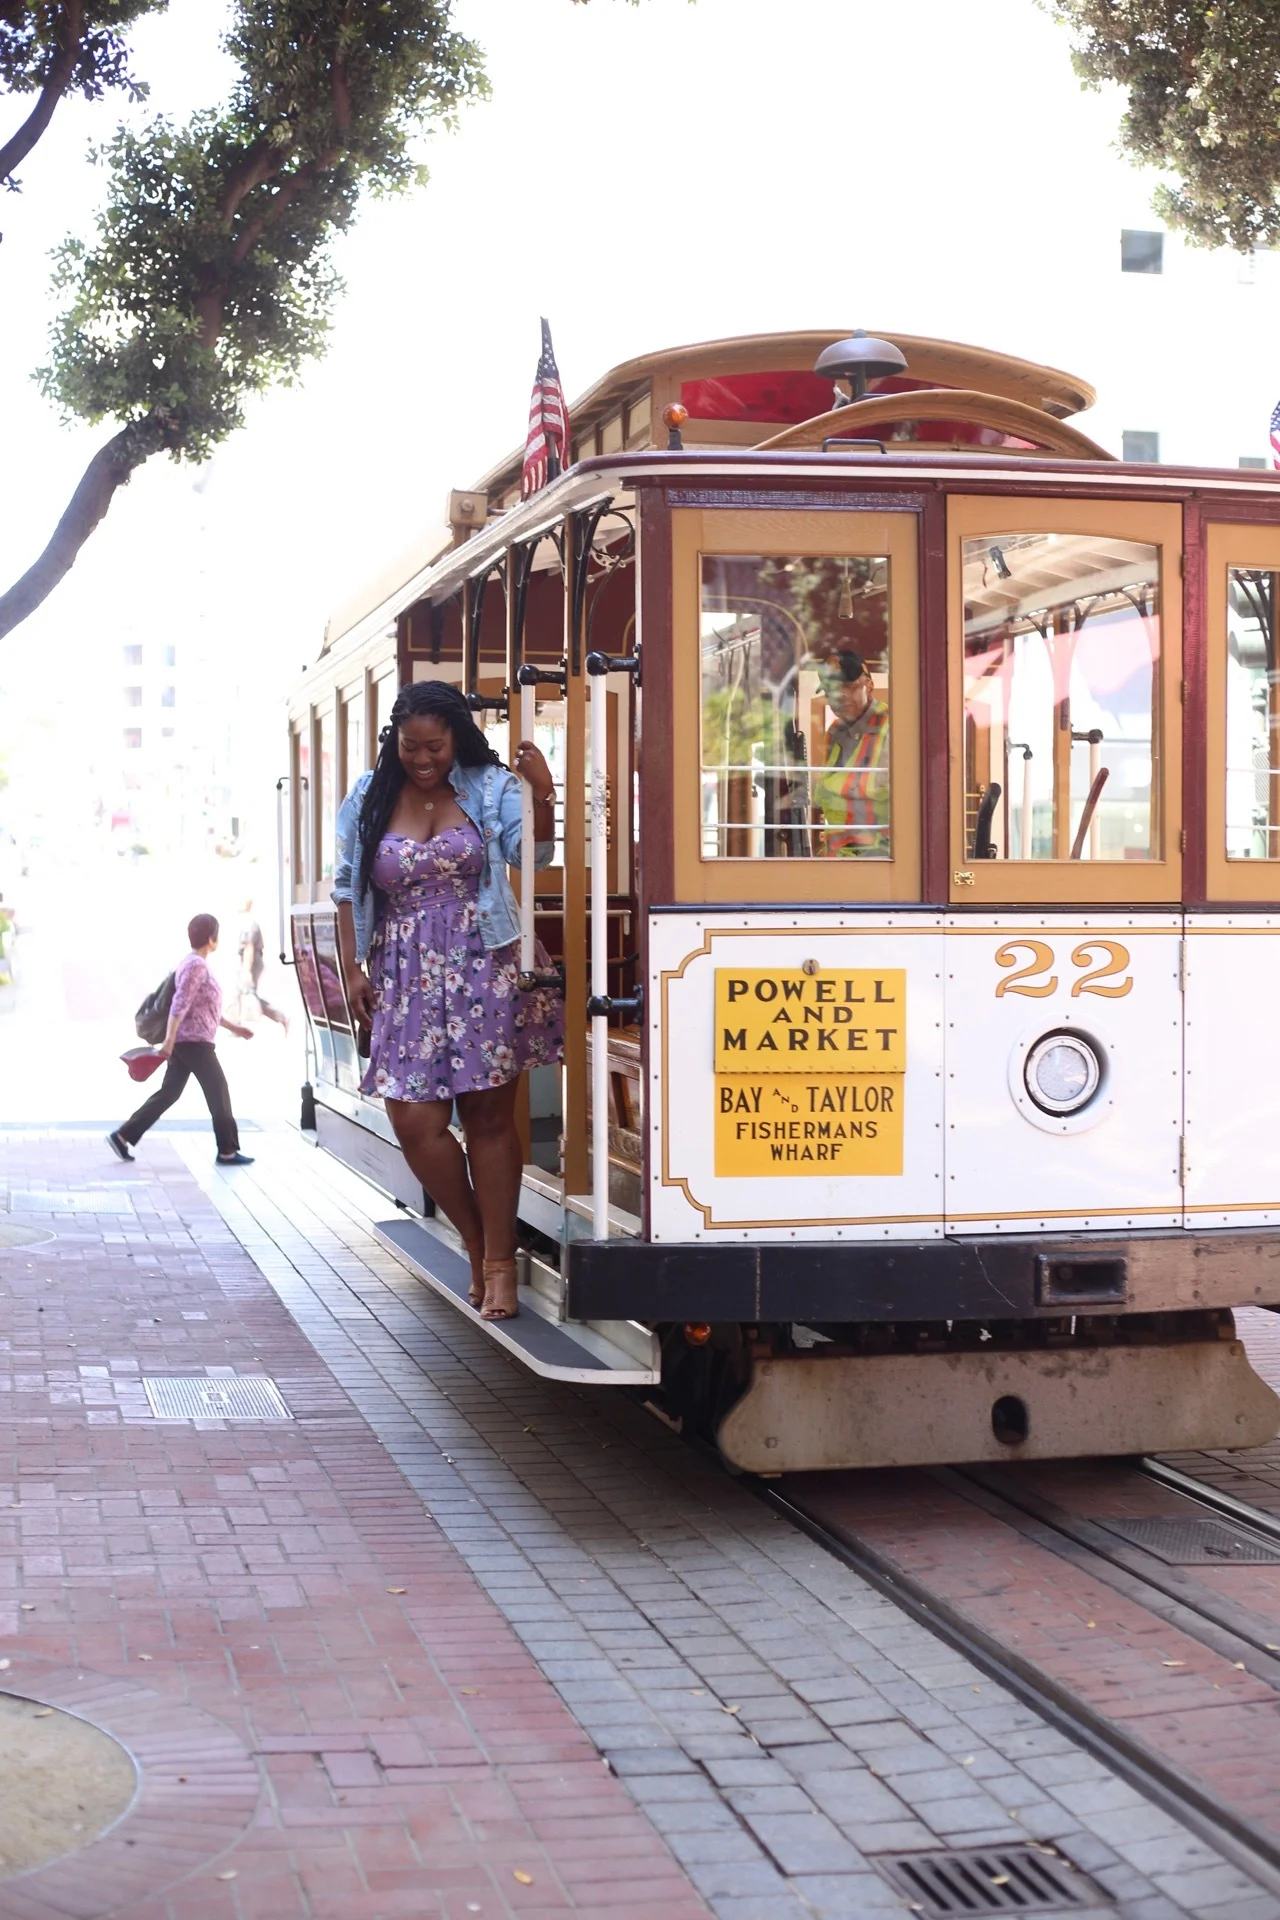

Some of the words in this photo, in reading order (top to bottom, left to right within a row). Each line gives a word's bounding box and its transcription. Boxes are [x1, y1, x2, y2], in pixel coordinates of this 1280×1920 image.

[994, 940, 1134, 998] 22
[728, 979, 895, 1003] POWELL
[772, 1006, 853, 1024] AND
[723, 1028, 898, 1051] MARKET
[720, 1086, 763, 1114] BAY
[772, 1088, 799, 1113] AND
[806, 1086, 894, 1113] TAYLOR
[736, 1121, 878, 1140] FISHERMANS
[770, 1143, 844, 1161] WHARF
